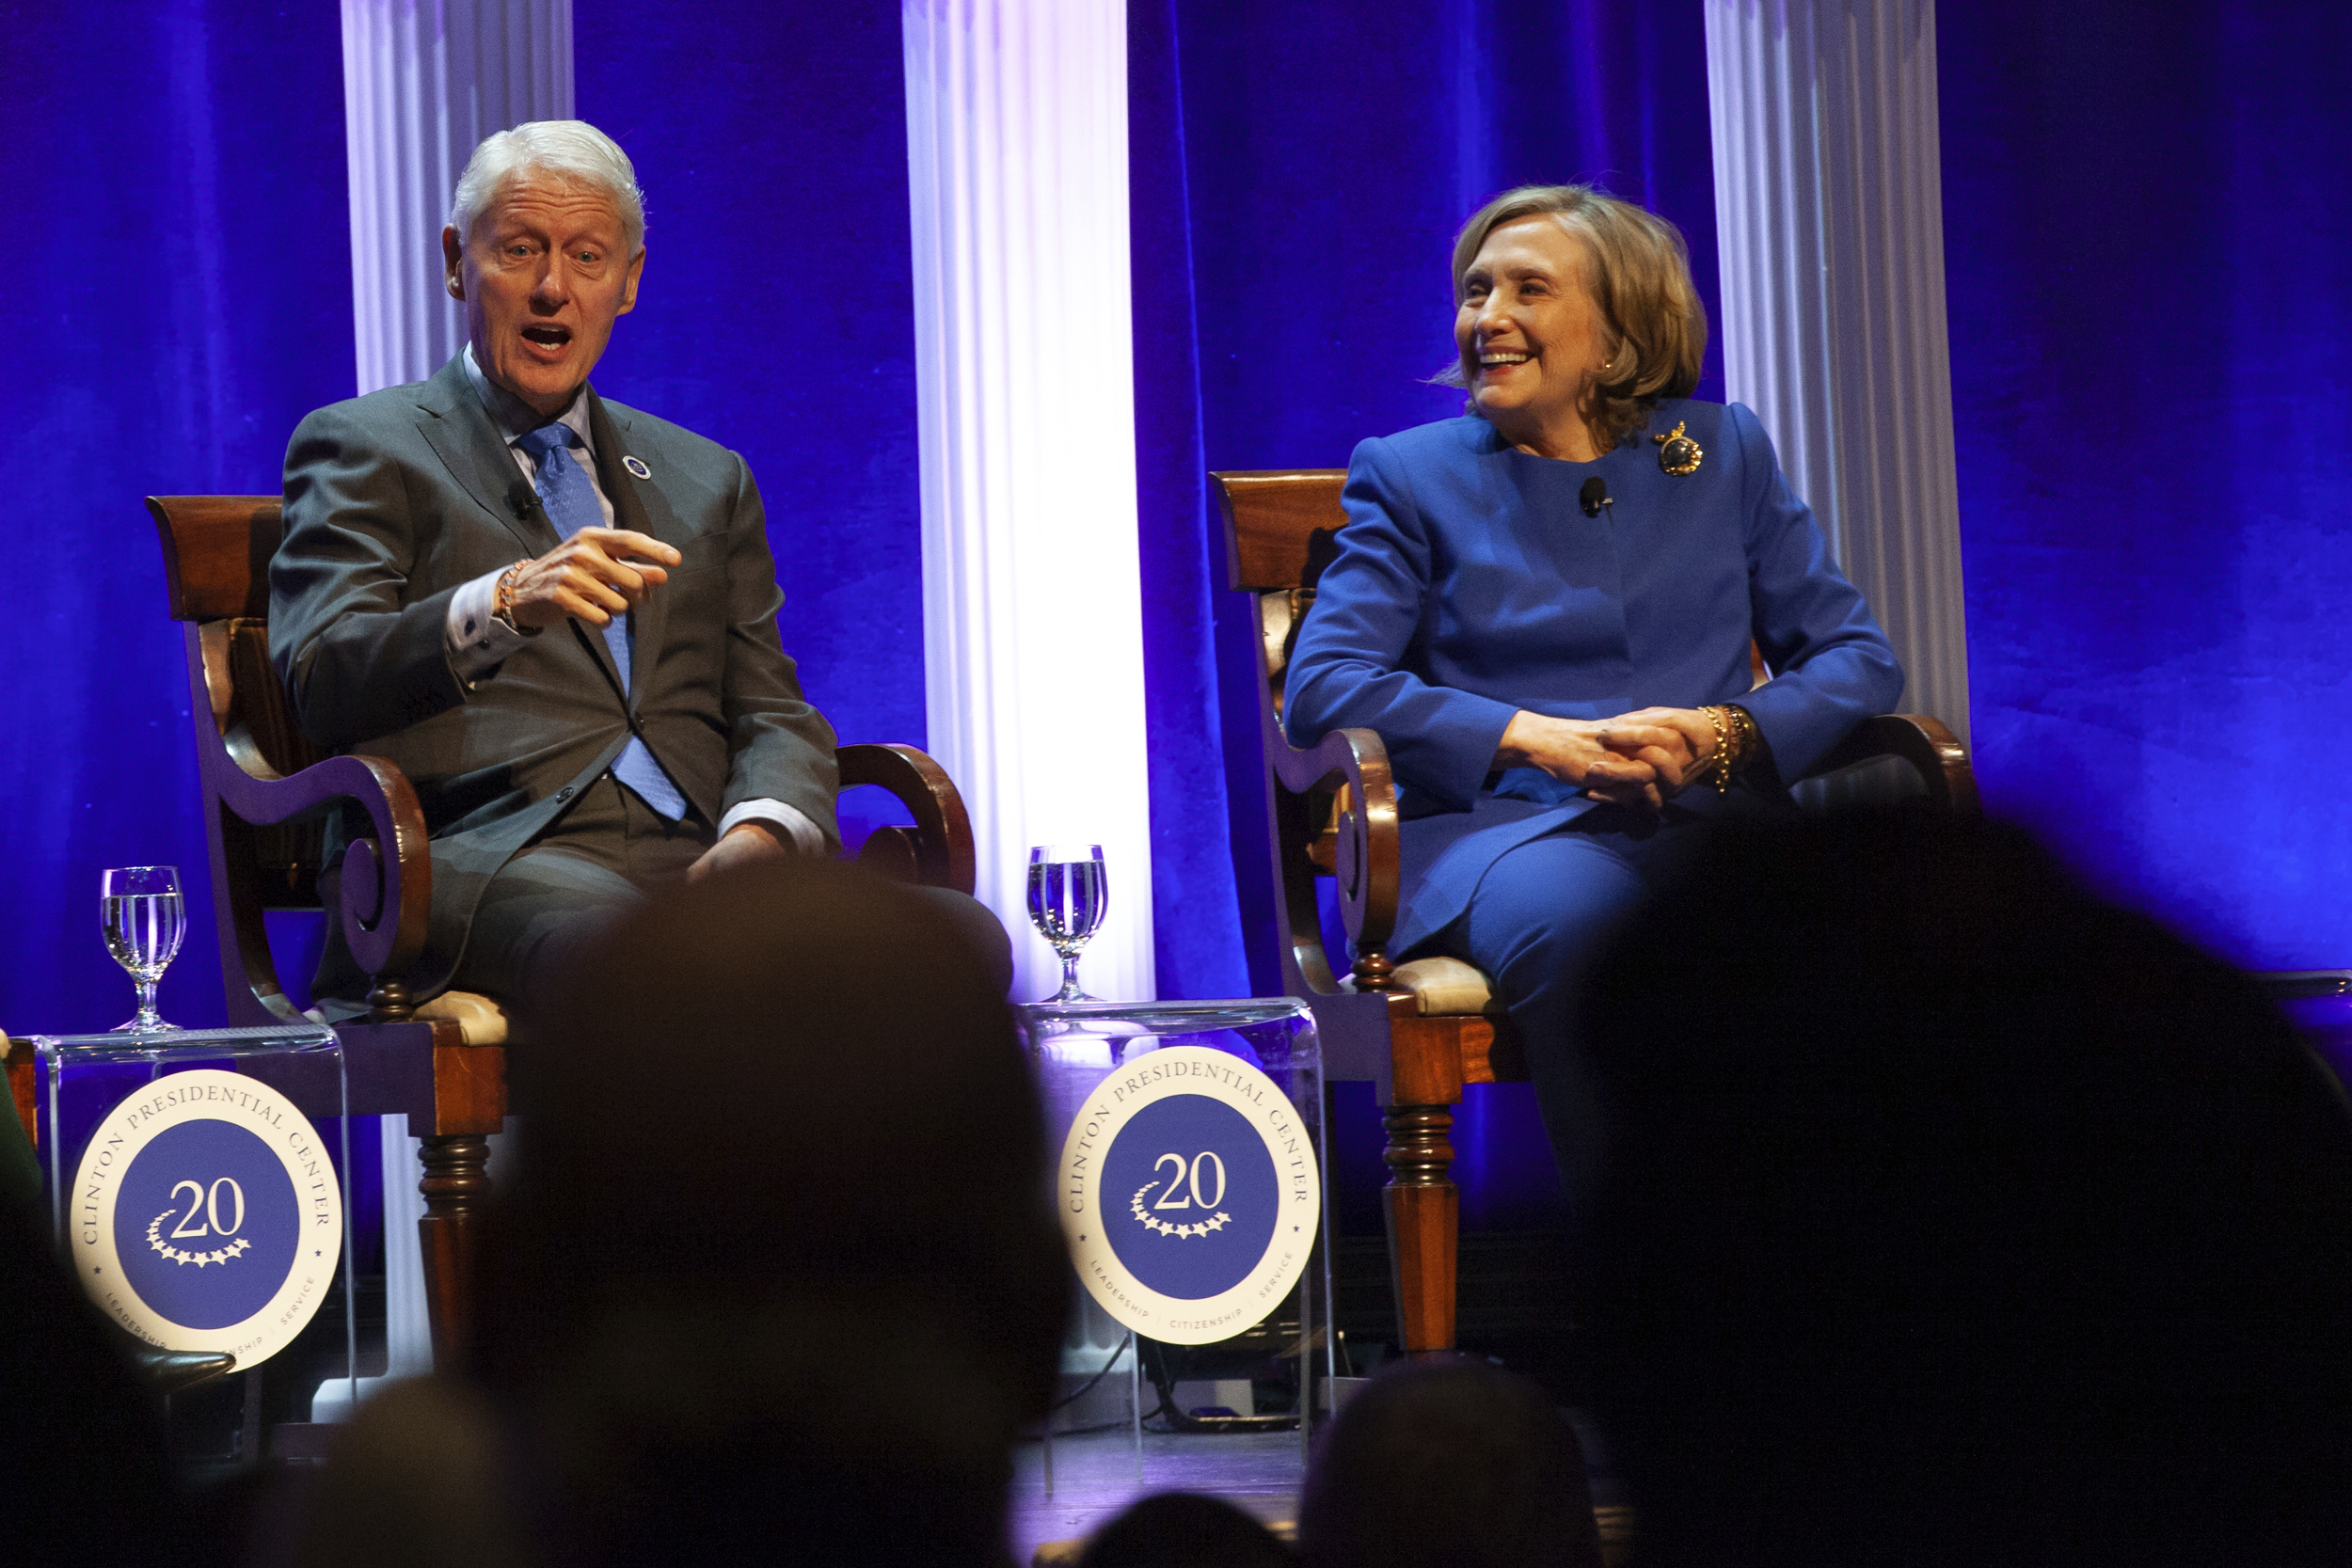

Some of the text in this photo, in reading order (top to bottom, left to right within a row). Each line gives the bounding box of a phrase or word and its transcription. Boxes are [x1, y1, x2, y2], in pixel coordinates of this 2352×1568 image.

[85, 1085, 329, 1244] CLINTON PRESIDENTIAL CENTER
[1071, 1061, 1307, 1212] CLINTON PRESIDENTIAL CENTER
[170, 1177, 245, 1239] 20
[1153, 1151, 1226, 1210] 20
[280, 1276, 314, 1325] SERVICE
[1091, 1252, 1292, 1329] LEADERSHIP CITIZENSHIP SERVICE
